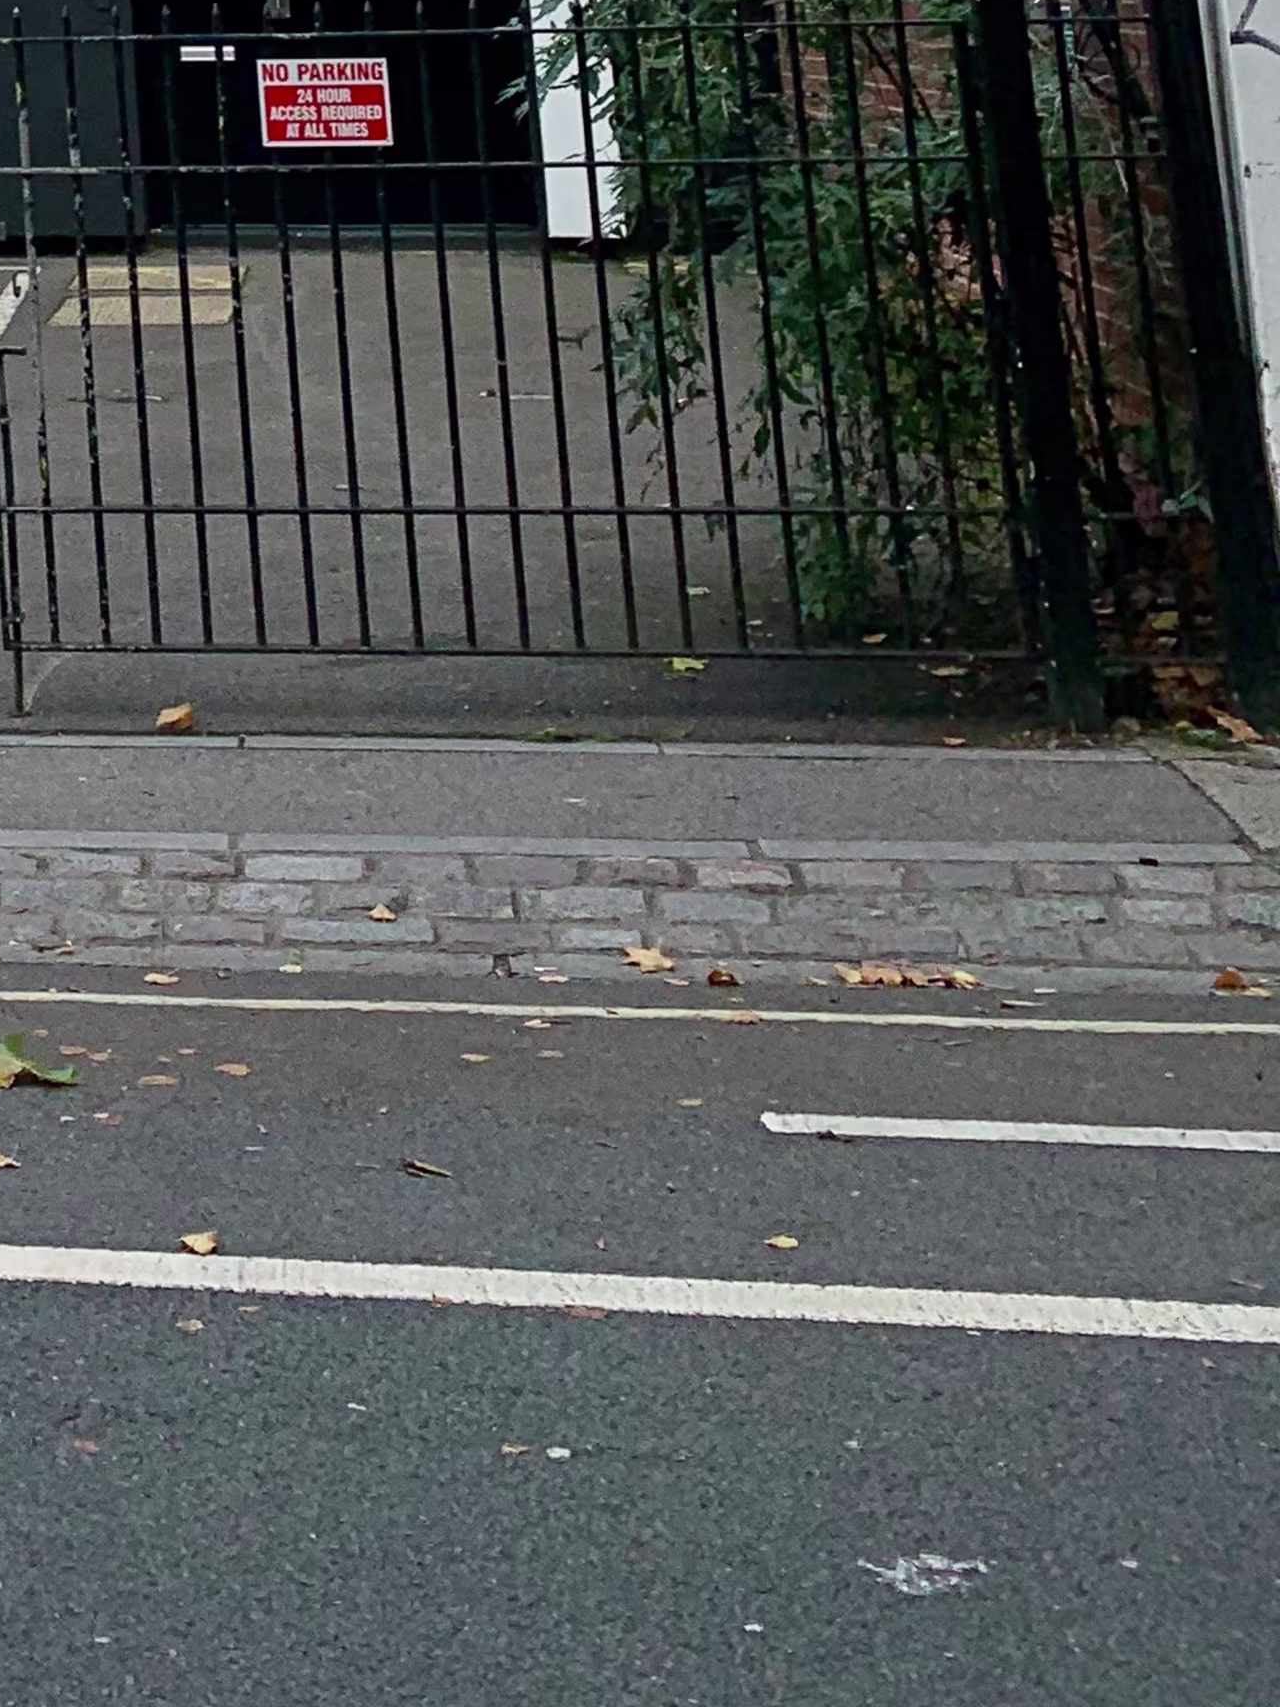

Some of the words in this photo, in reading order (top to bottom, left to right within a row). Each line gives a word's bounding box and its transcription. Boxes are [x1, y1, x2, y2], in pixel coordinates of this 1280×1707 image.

[261, 64, 288, 82] NO
[297, 62, 384, 81] PARKING
[297, 89, 313, 103] 24
[317, 88, 351, 103] HOUR
[270, 105, 317, 121] ACCESS
[321, 105, 382, 121] REQUIRED
[286, 123, 300, 138] AT
[304, 123, 326, 138] ALL
[329, 122, 369, 137] TIMES
